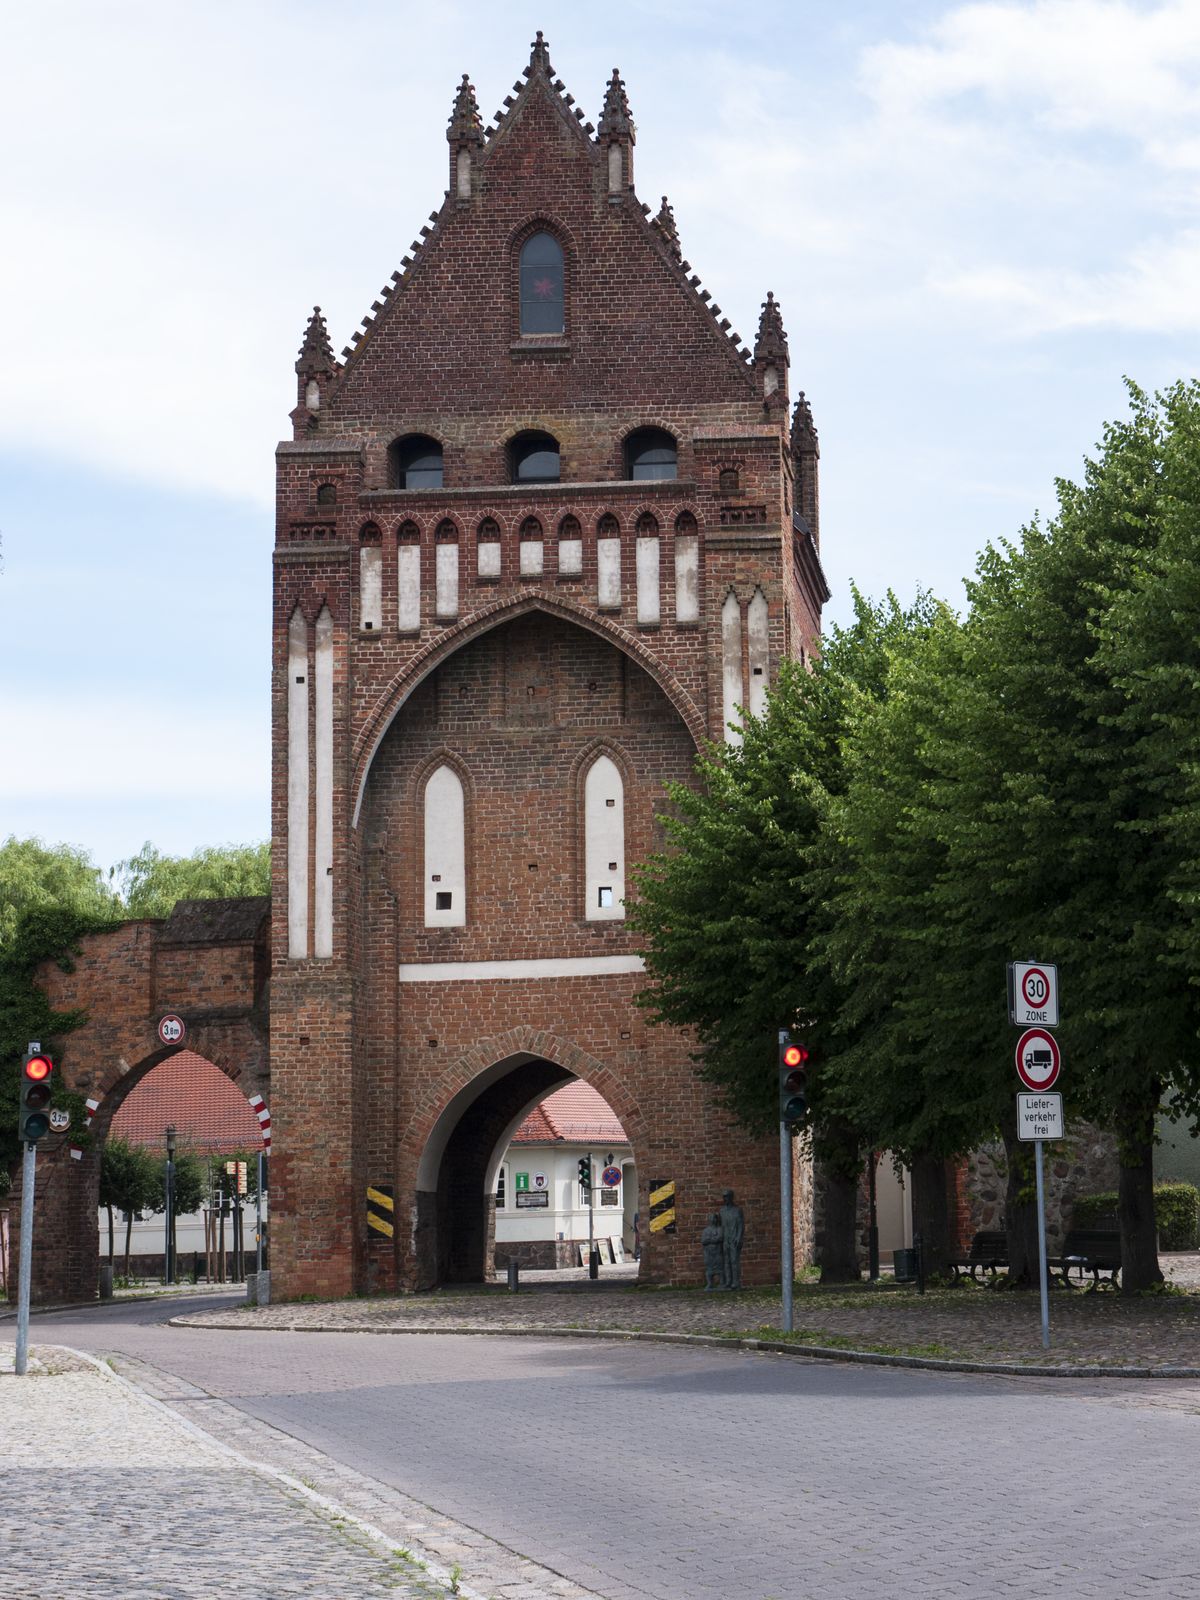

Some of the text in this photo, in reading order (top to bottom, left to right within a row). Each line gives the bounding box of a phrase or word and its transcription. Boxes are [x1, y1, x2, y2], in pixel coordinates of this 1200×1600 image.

[1027, 979, 1044, 998] 30
[1026, 1010, 1047, 1021] ZONE
[1026, 1099, 1054, 1109] Liefer-
[1024, 1111, 1056, 1122] verkehr
[1034, 1124, 1049, 1135] frei
